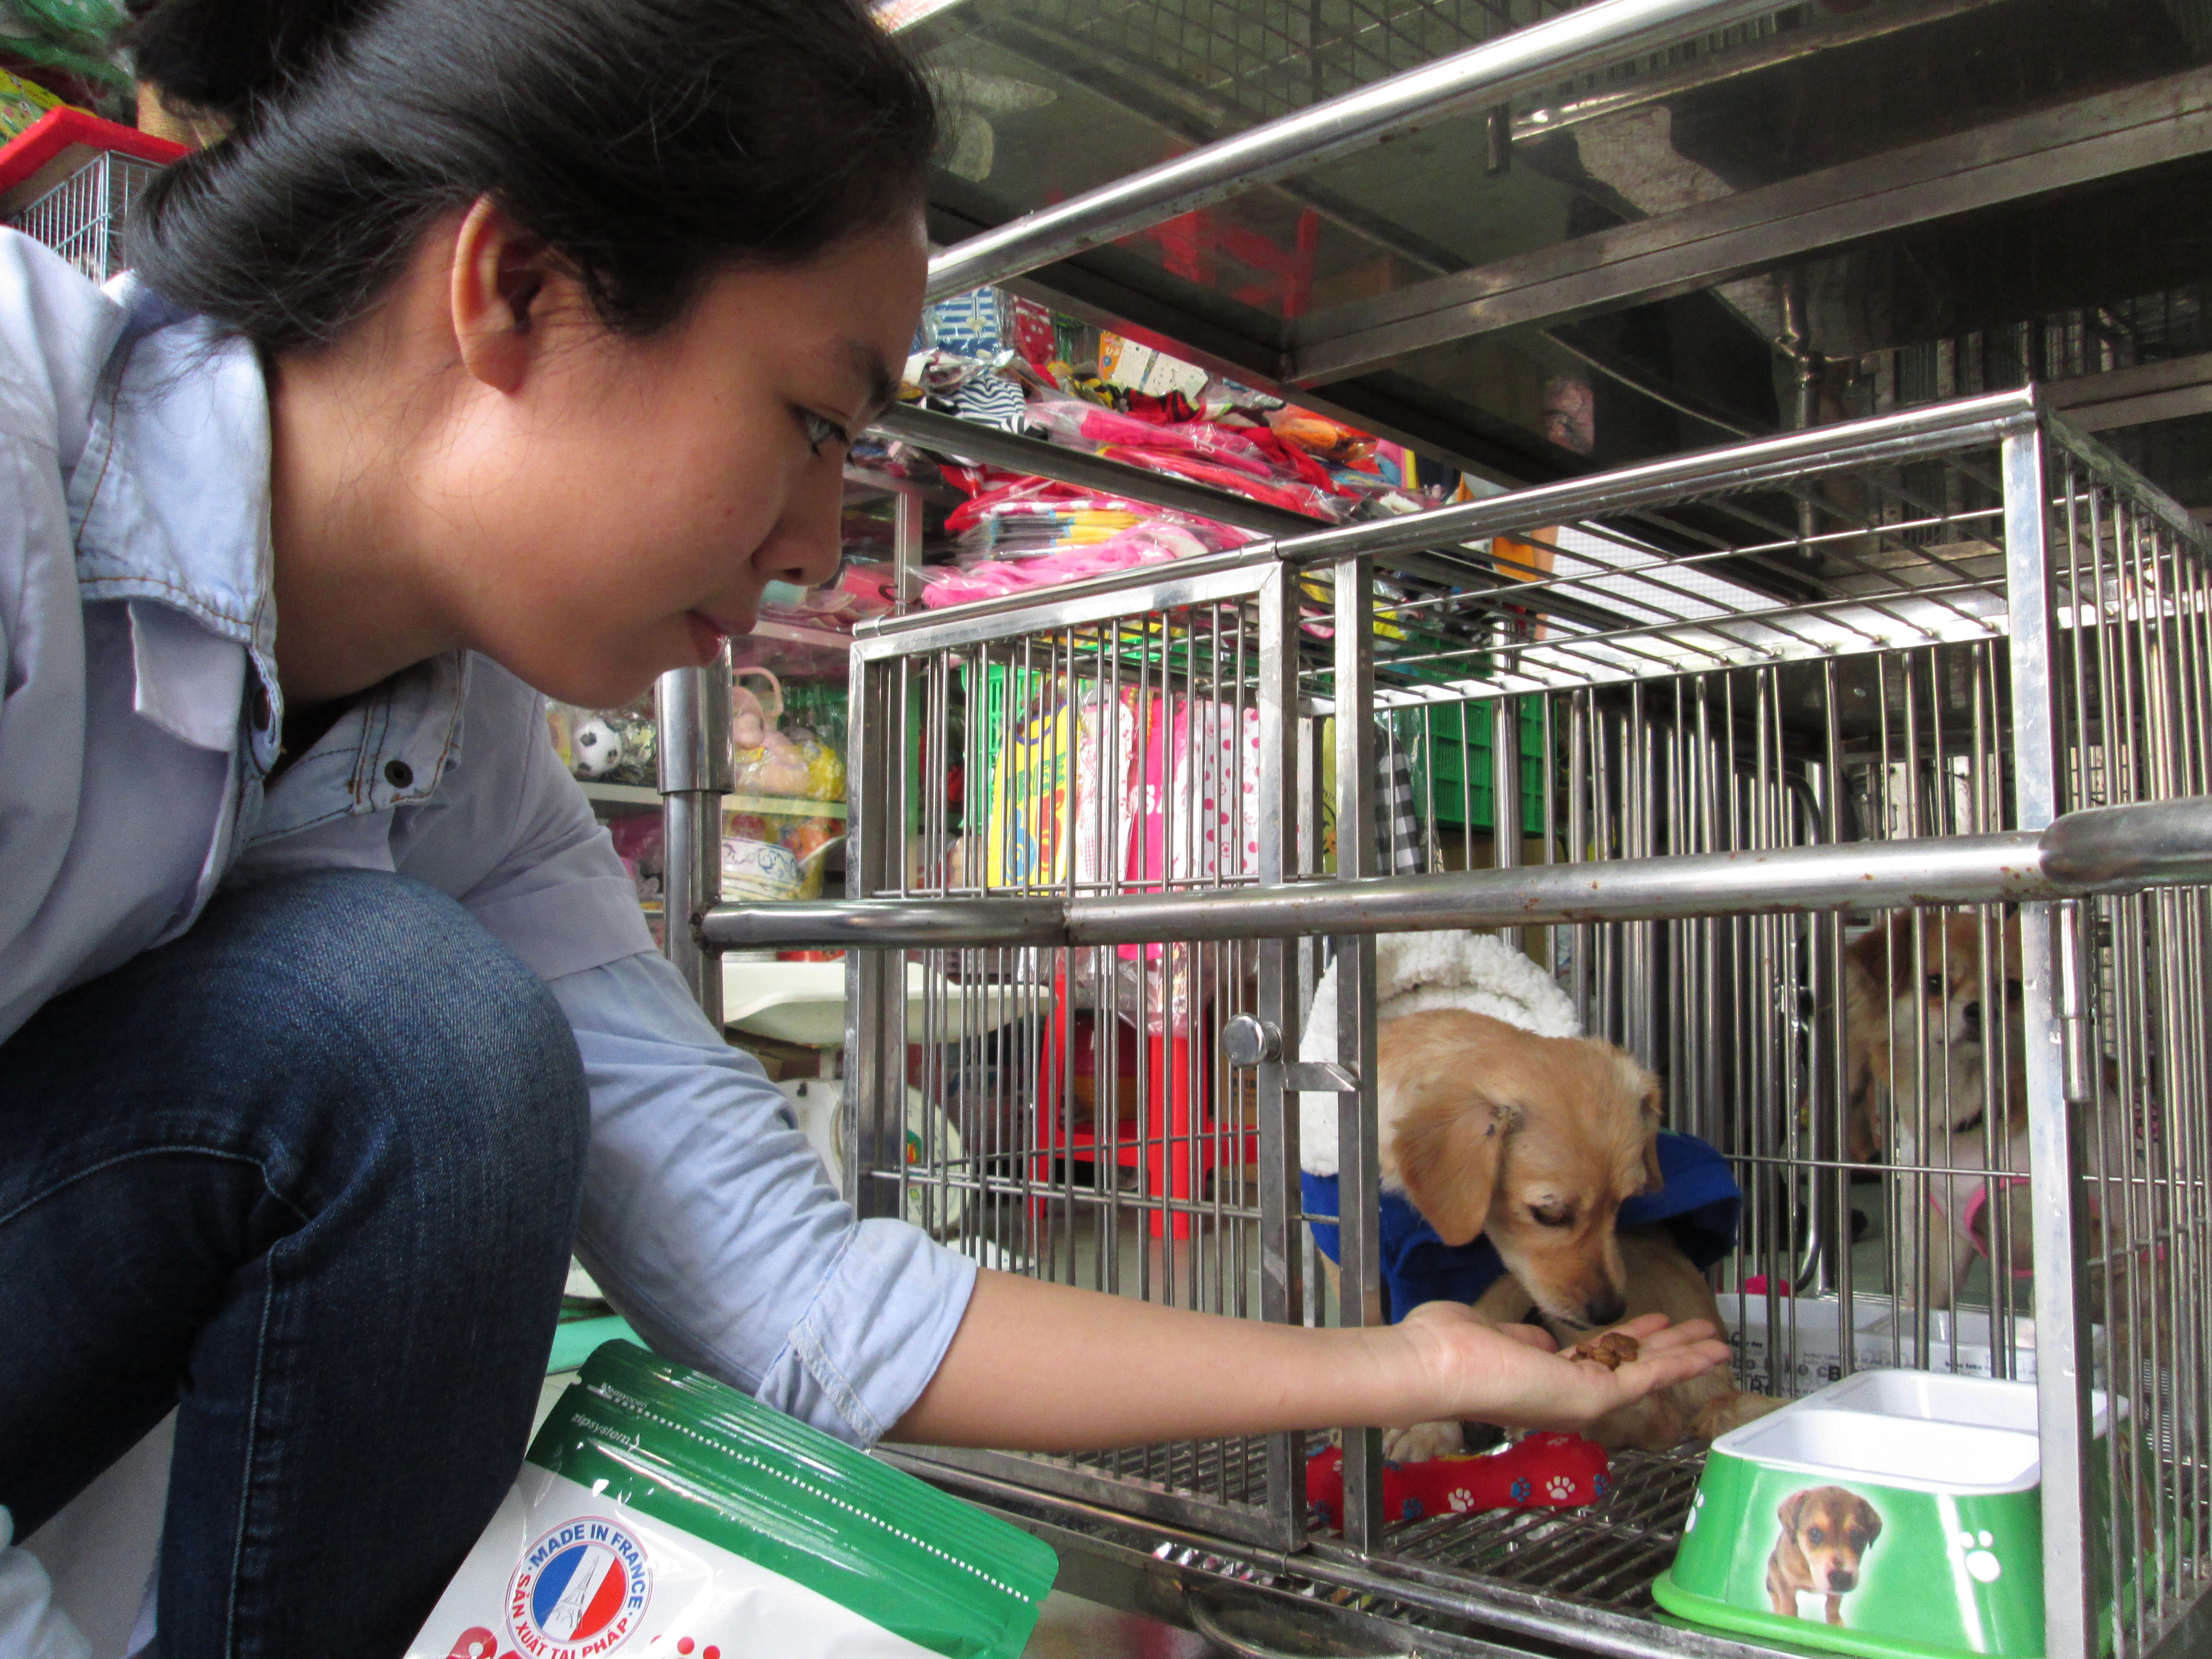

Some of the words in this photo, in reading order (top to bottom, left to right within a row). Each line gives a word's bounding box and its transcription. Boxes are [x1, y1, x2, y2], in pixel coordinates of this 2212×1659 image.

[530, 1524, 585, 1568] MADE
[590, 1524, 609, 1541] IN
[611, 1531, 646, 1610] FRANCE
[512, 1573, 531, 1619] SẢN
[516, 1620, 548, 1657] XUẤT
[582, 1617, 627, 1658] PHÁP
